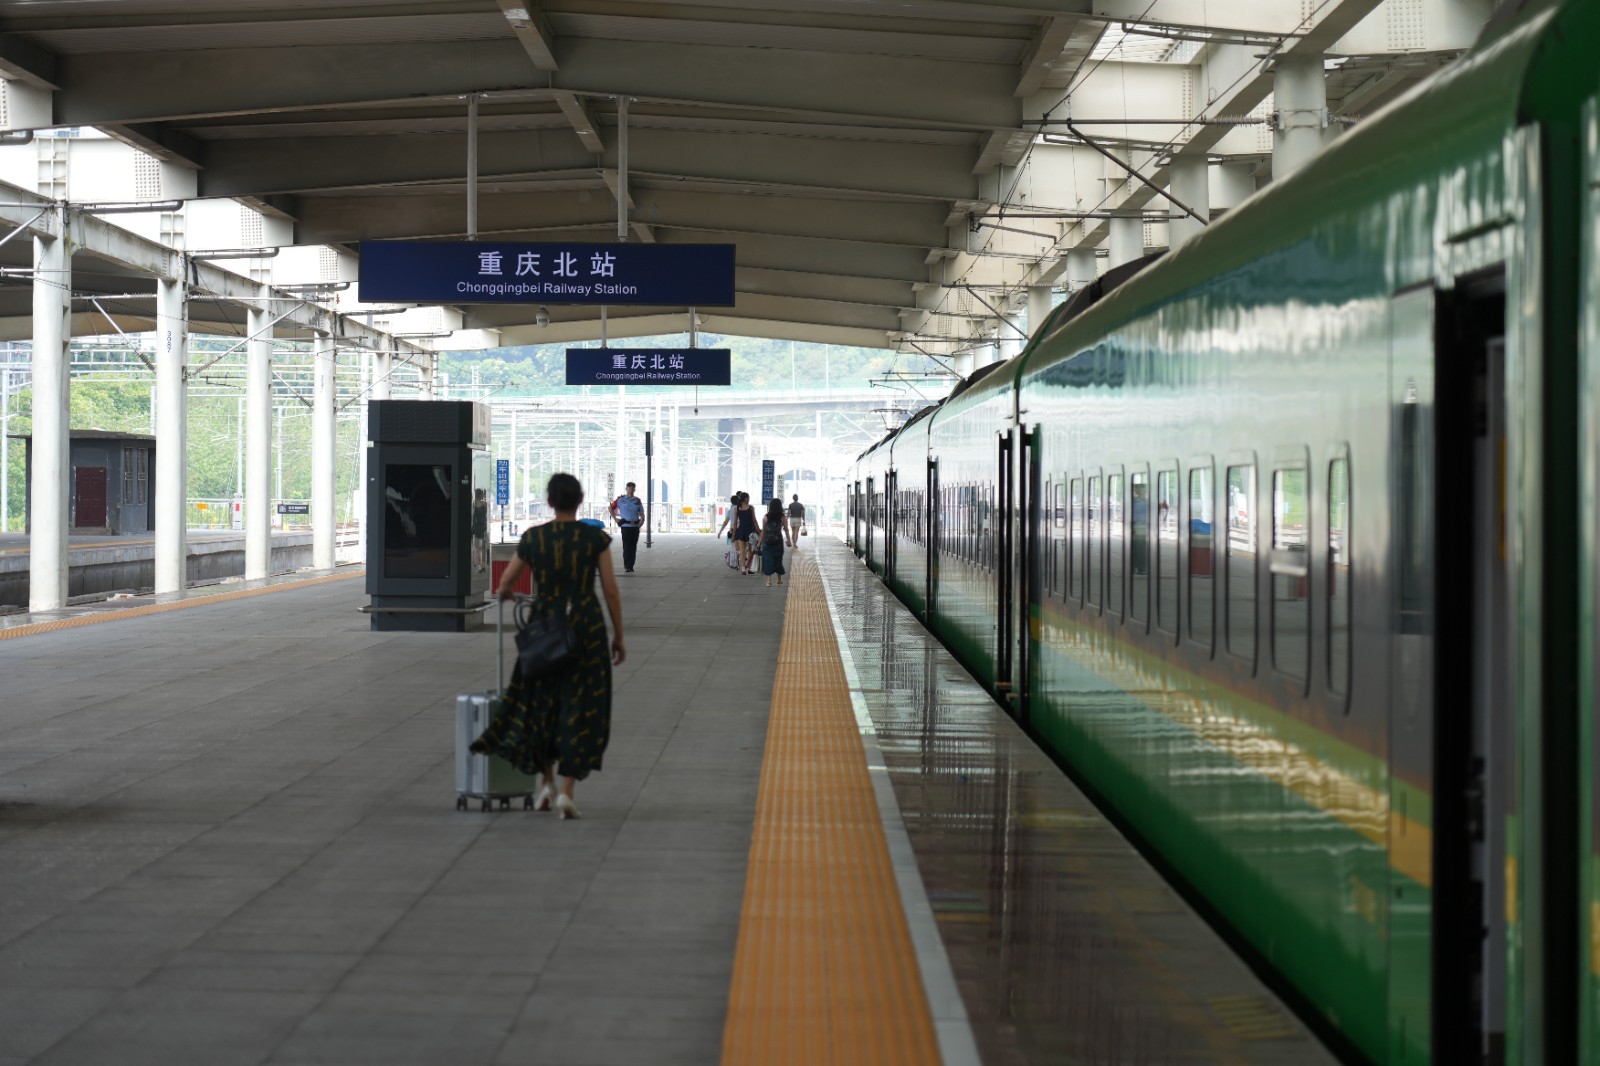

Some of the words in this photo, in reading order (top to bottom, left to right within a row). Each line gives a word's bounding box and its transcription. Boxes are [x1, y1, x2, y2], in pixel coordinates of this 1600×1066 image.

[478, 251, 616, 277] 重庆北站
[457, 281, 541, 296] Chongqingbei
[544, 283, 591, 297] Railway
[594, 284, 637, 295] Station
[612, 354, 685, 370] 重庆北站
[596, 372, 646, 380] Chongqingbei
[646, 372, 677, 380] Railway
[676, 372, 700, 380] Station
